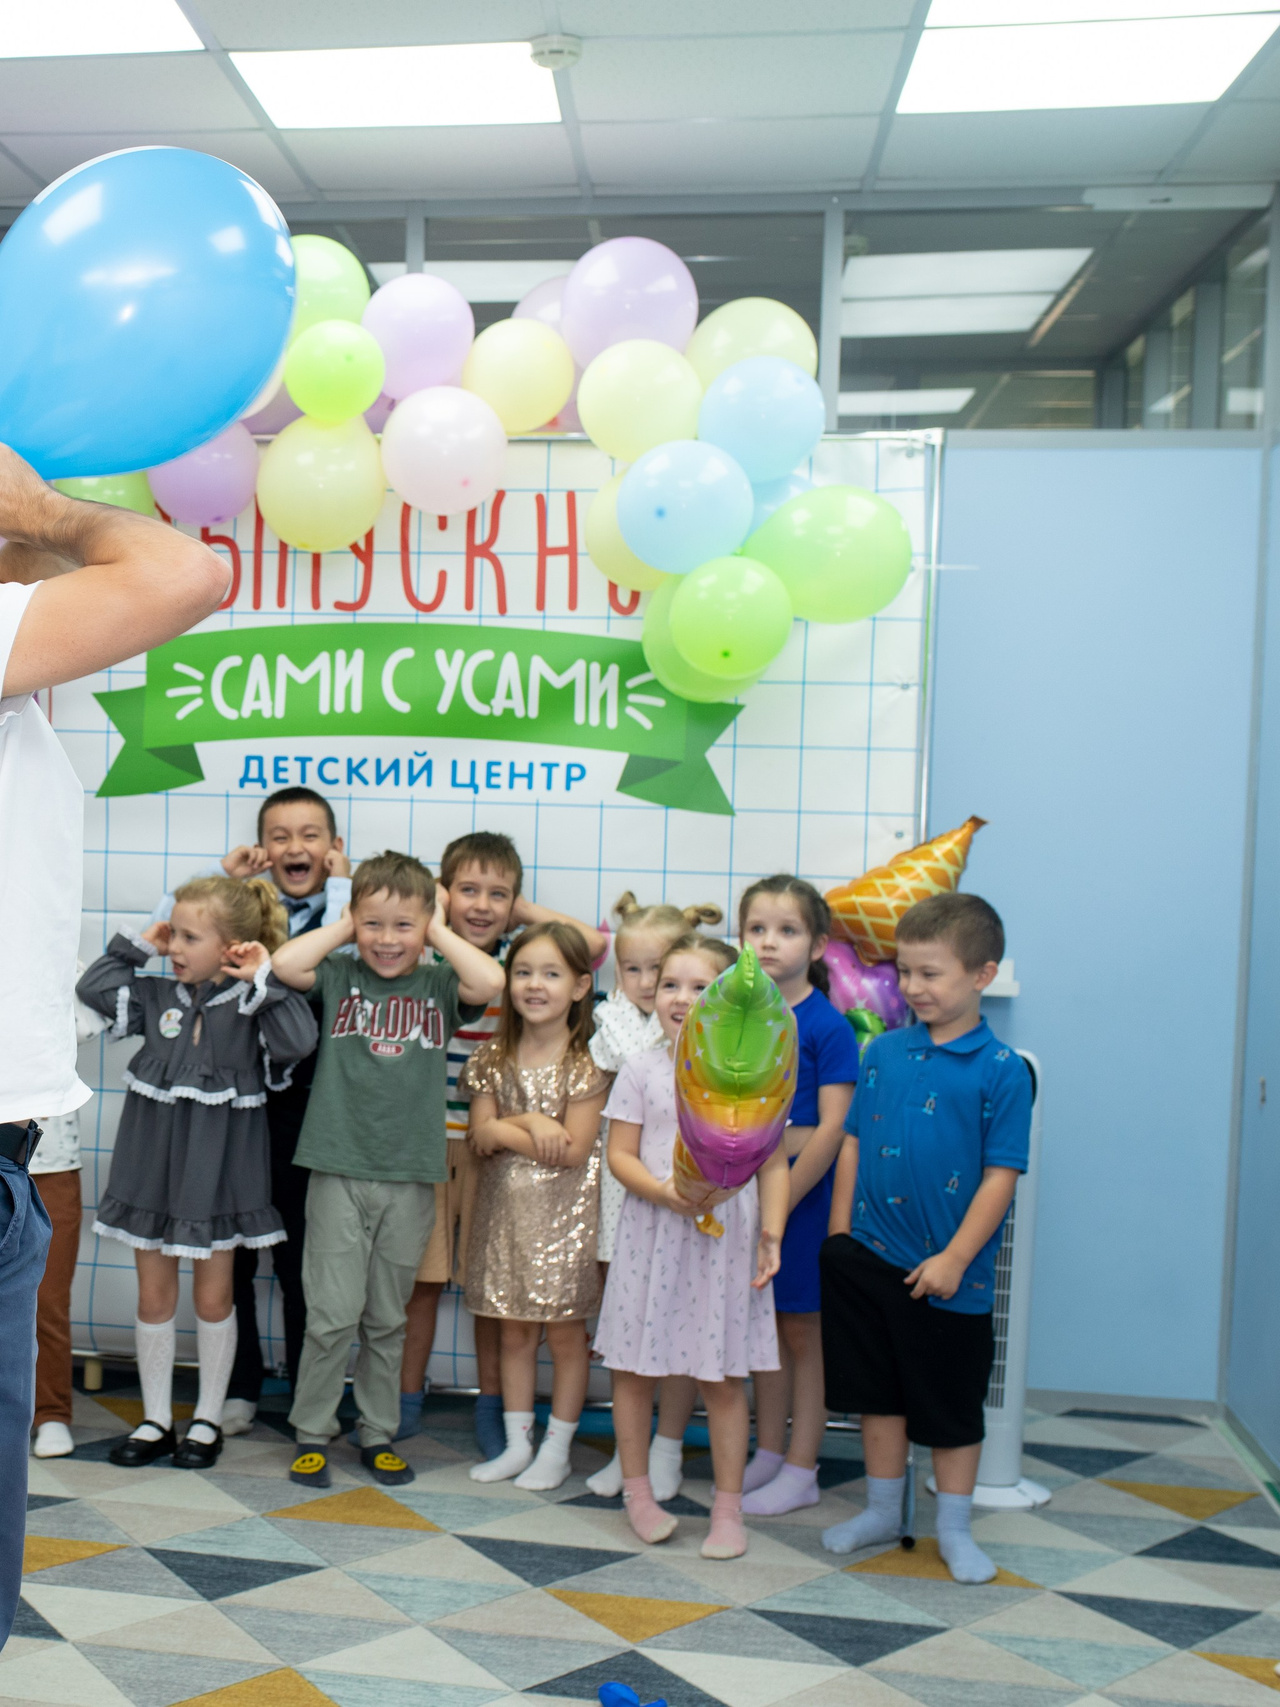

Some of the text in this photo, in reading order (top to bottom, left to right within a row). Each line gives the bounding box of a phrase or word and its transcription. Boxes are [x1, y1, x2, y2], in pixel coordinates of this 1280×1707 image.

[210, 647, 620, 730] САМИ С УСАМИ
[238, 751, 588, 795] ДЕТСКИЙ ЦЕНТР
